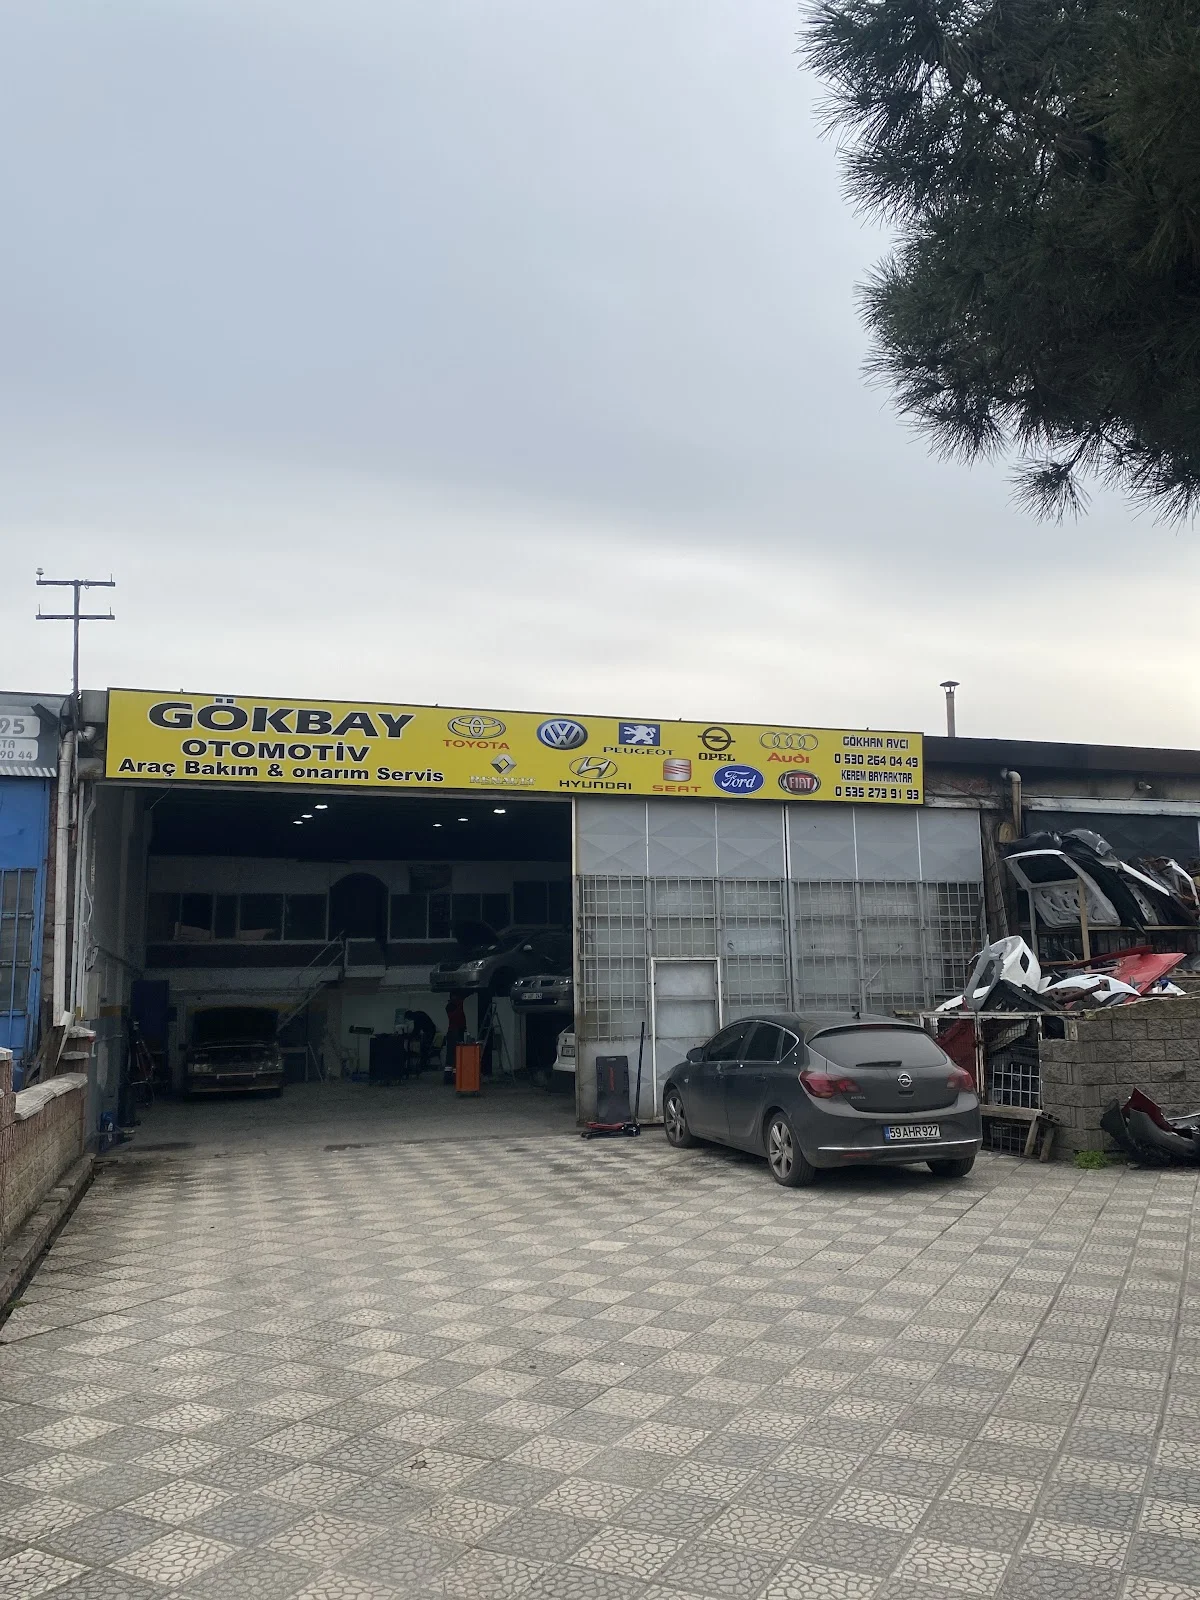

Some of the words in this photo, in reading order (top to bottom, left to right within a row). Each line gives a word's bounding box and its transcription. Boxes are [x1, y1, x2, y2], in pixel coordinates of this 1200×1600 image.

[149, 698, 414, 737] GÖKBAY
[443, 740, 510, 750] TOYOTA
[843, 735, 883, 748] GÖKHAN
[886, 738, 909, 749] AVCI
[18, 751, 33, 759] 44
[181, 739, 370, 762] OTOMOTİV
[603, 746, 675, 756] PEUGEOT
[698, 752, 736, 762] OPEL
[767, 752, 810, 764] Audi
[834, 753, 841, 764] 0
[844, 754, 864, 765] 530
[867, 755, 887, 766] 264
[889, 756, 903, 767] 04
[905, 757, 918, 768] 49
[118, 758, 176, 776] Araç
[185, 760, 258, 777] Bakım
[267, 763, 283, 777] &
[292, 767, 369, 780] onarım
[377, 767, 444, 782] Servis
[841, 770, 866, 781] KEREM
[868, 771, 913, 783] BAYRAKTAR
[559, 780, 632, 790] HYUNDAI
[721, 770, 757, 788] Ford
[789, 776, 812, 789] FIAT
[652, 784, 702, 793] SEAT
[835, 786, 842, 797] 0
[845, 787, 865, 798] 535
[868, 788, 887, 799] 273
[890, 788, 902, 799] 91
[906, 790, 919, 800] 93
